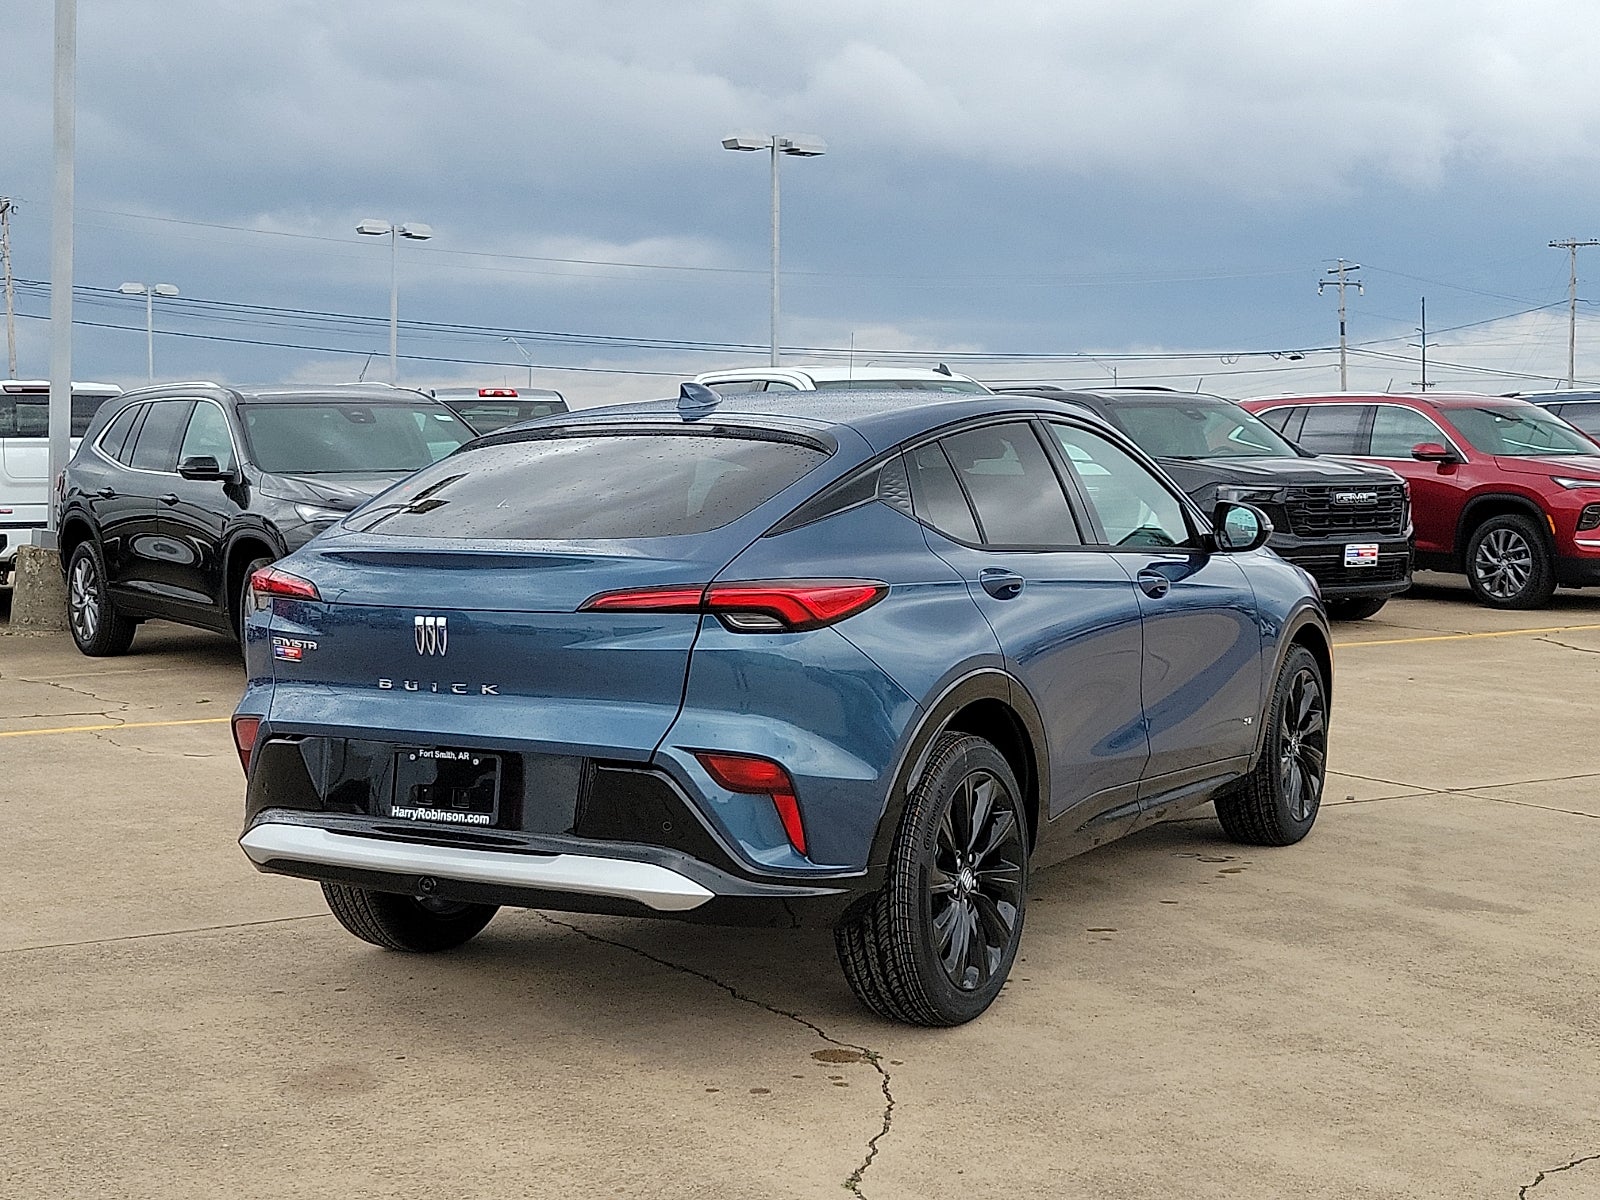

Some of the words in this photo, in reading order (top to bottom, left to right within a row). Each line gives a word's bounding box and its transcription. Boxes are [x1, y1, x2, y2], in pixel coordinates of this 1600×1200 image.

[1335, 492, 1378, 504] GMC
[378, 678, 500, 695] BUICK
[419, 749, 434, 758] Fort
[434, 751, 457, 760] Smith,
[458, 752, 470, 760] AR
[391, 805, 490, 825] HarryRobinson.com
